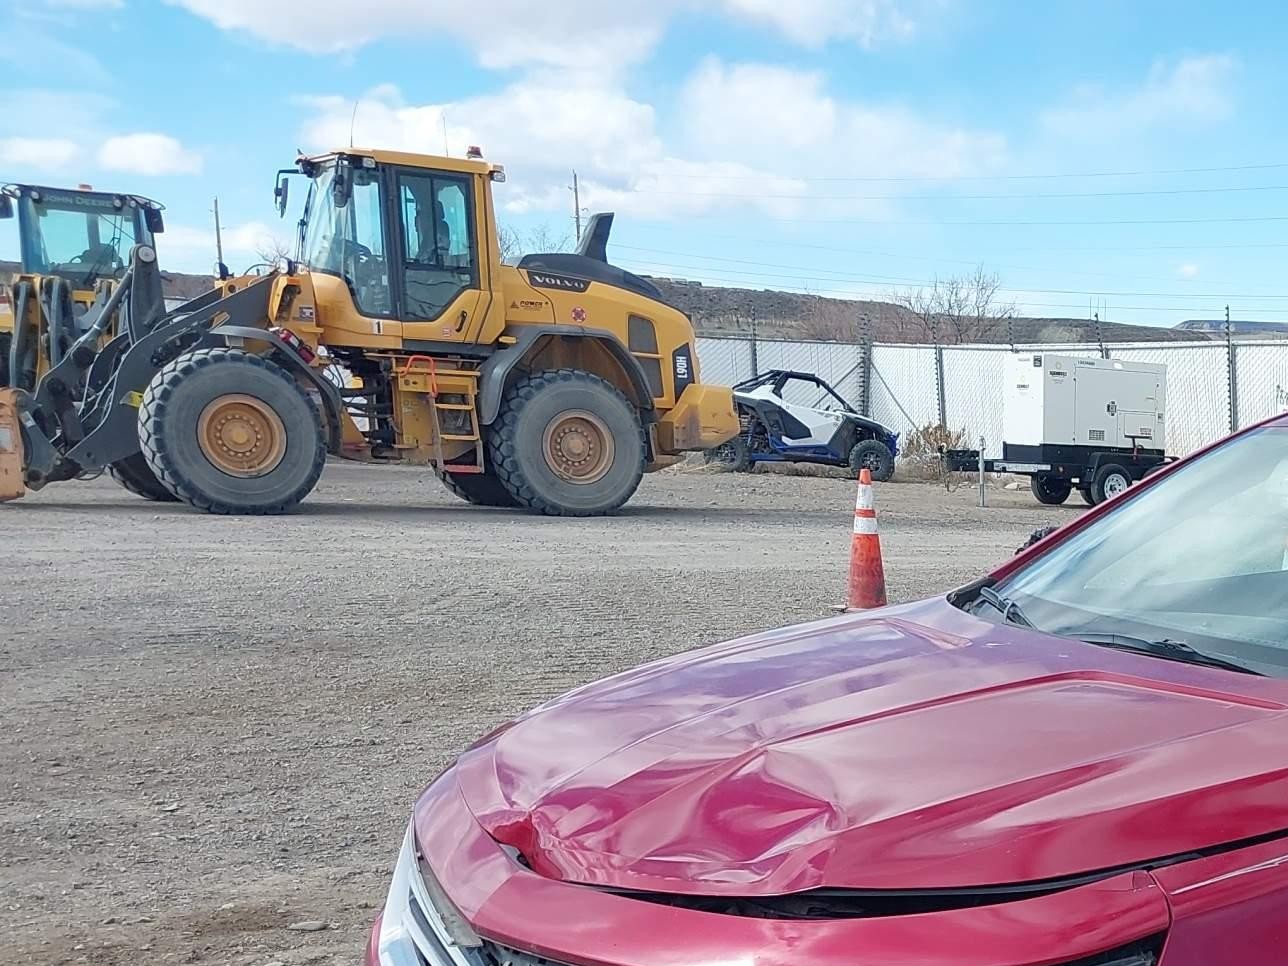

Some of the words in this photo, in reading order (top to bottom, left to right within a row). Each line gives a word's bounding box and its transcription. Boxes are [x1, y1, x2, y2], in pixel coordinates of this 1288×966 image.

[43, 194, 73, 204] JOHN
[75, 196, 113, 207] DEERE
[533, 275, 585, 289] VOLVO
[676, 356, 688, 379] L90H
